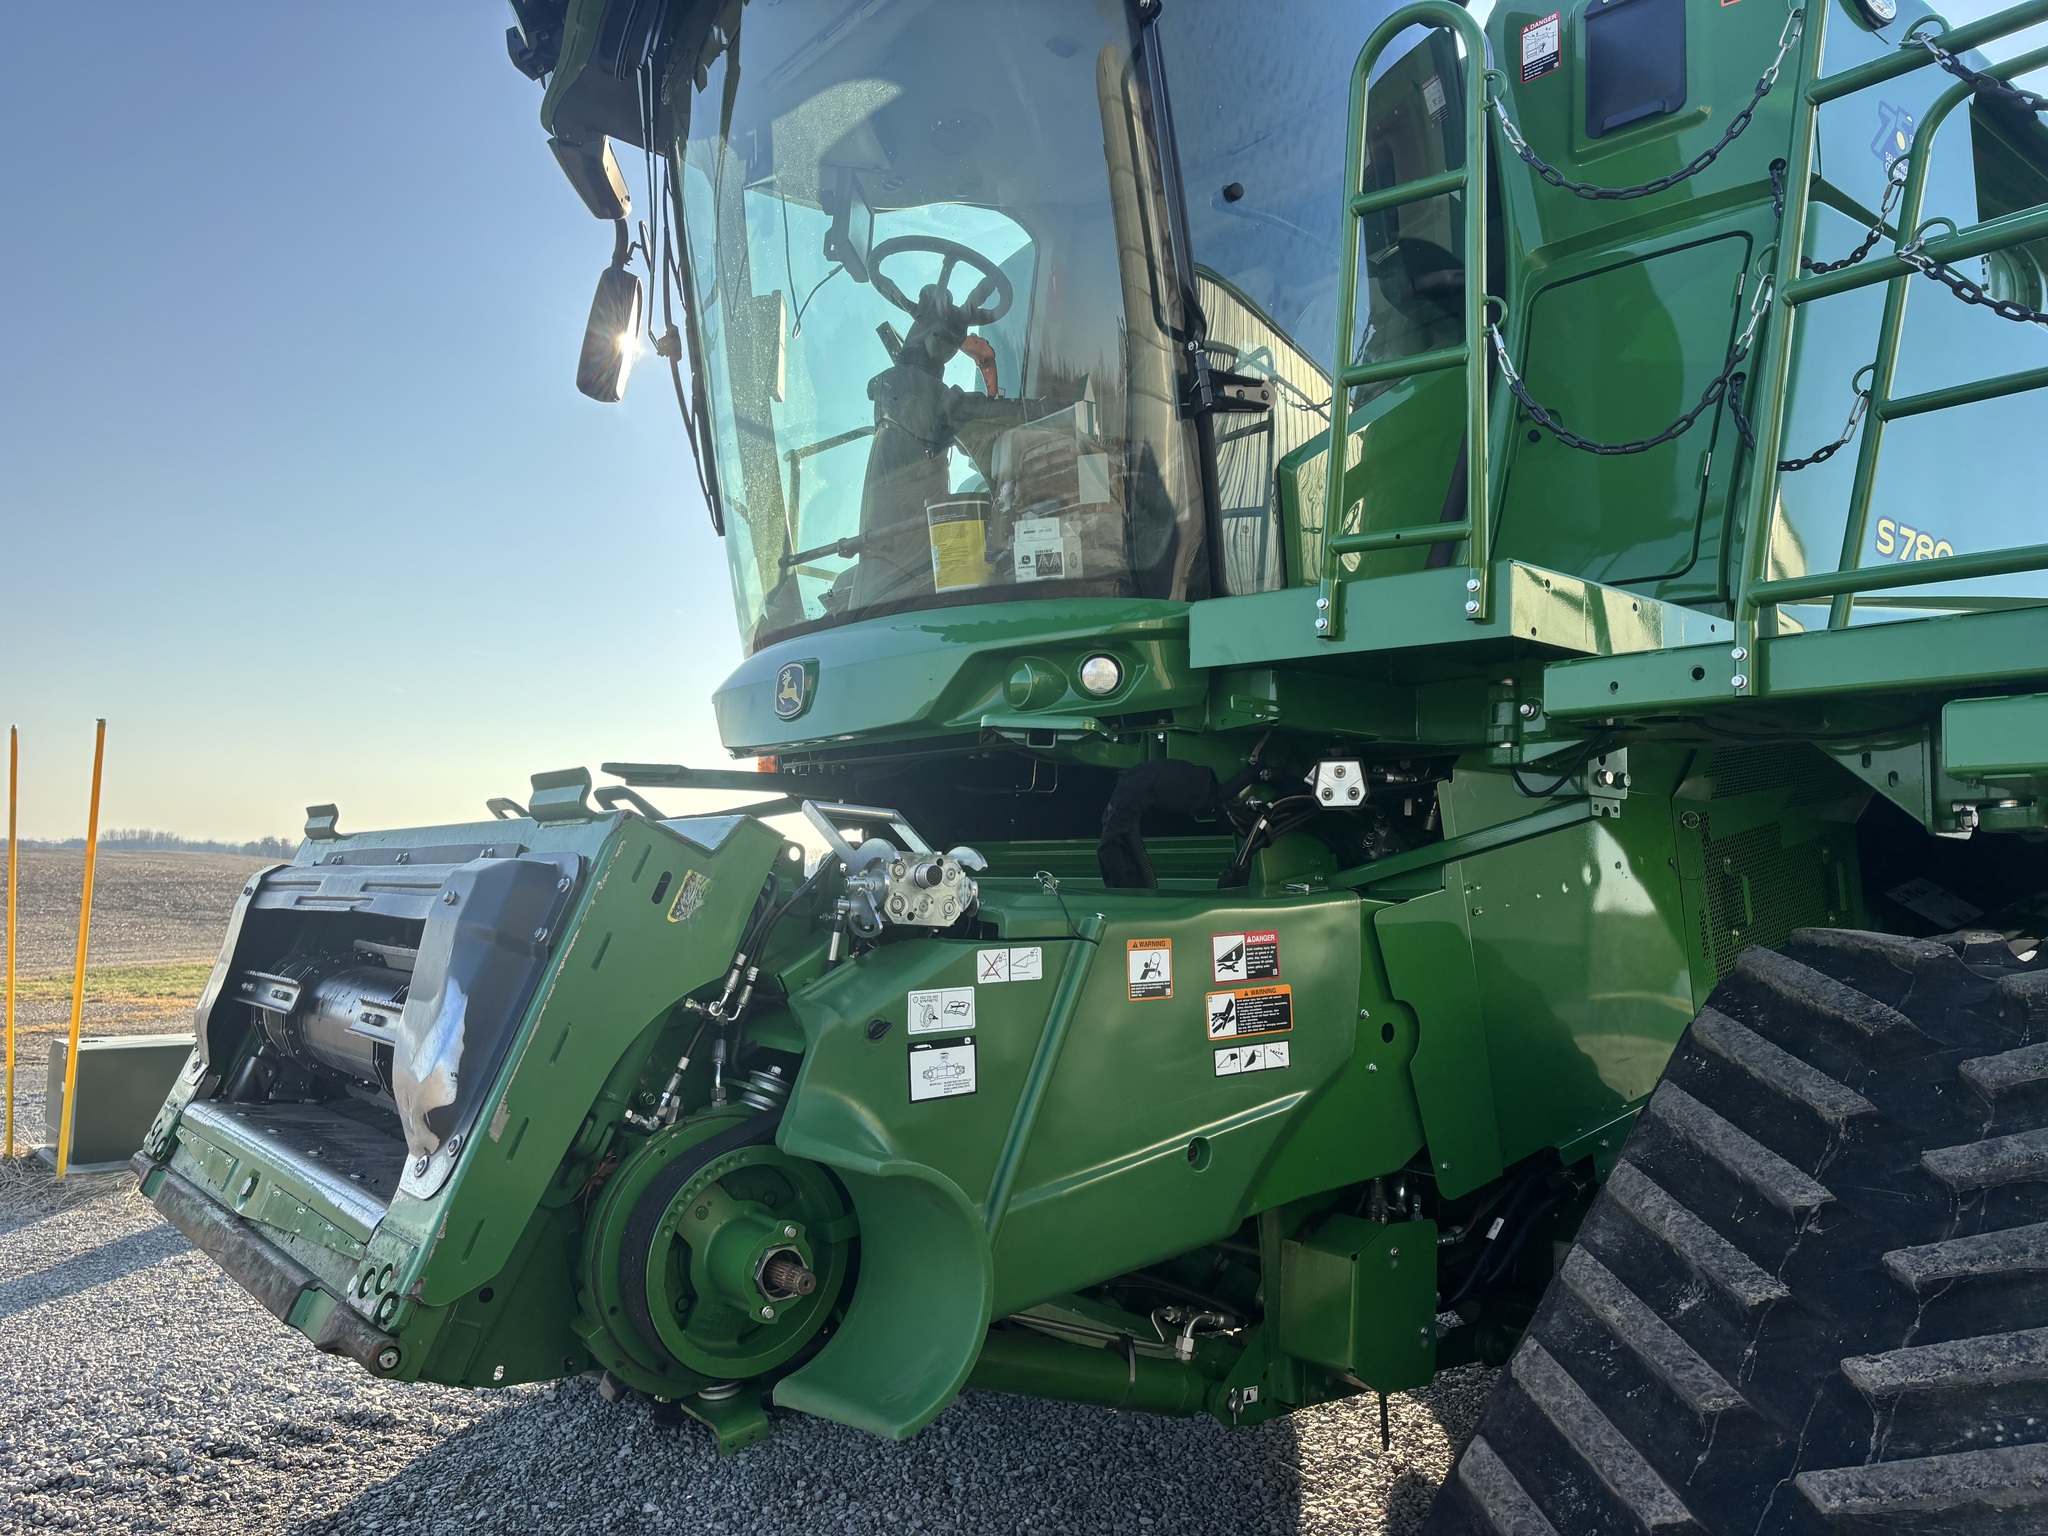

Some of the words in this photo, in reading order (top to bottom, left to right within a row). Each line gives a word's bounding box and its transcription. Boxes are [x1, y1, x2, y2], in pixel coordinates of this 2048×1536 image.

[1530, 13, 1557, 30] DANGER
[1251, 934, 1276, 943] DANGER
[1139, 940, 1166, 948] WARNING
[1250, 987, 1277, 996] WARNING
